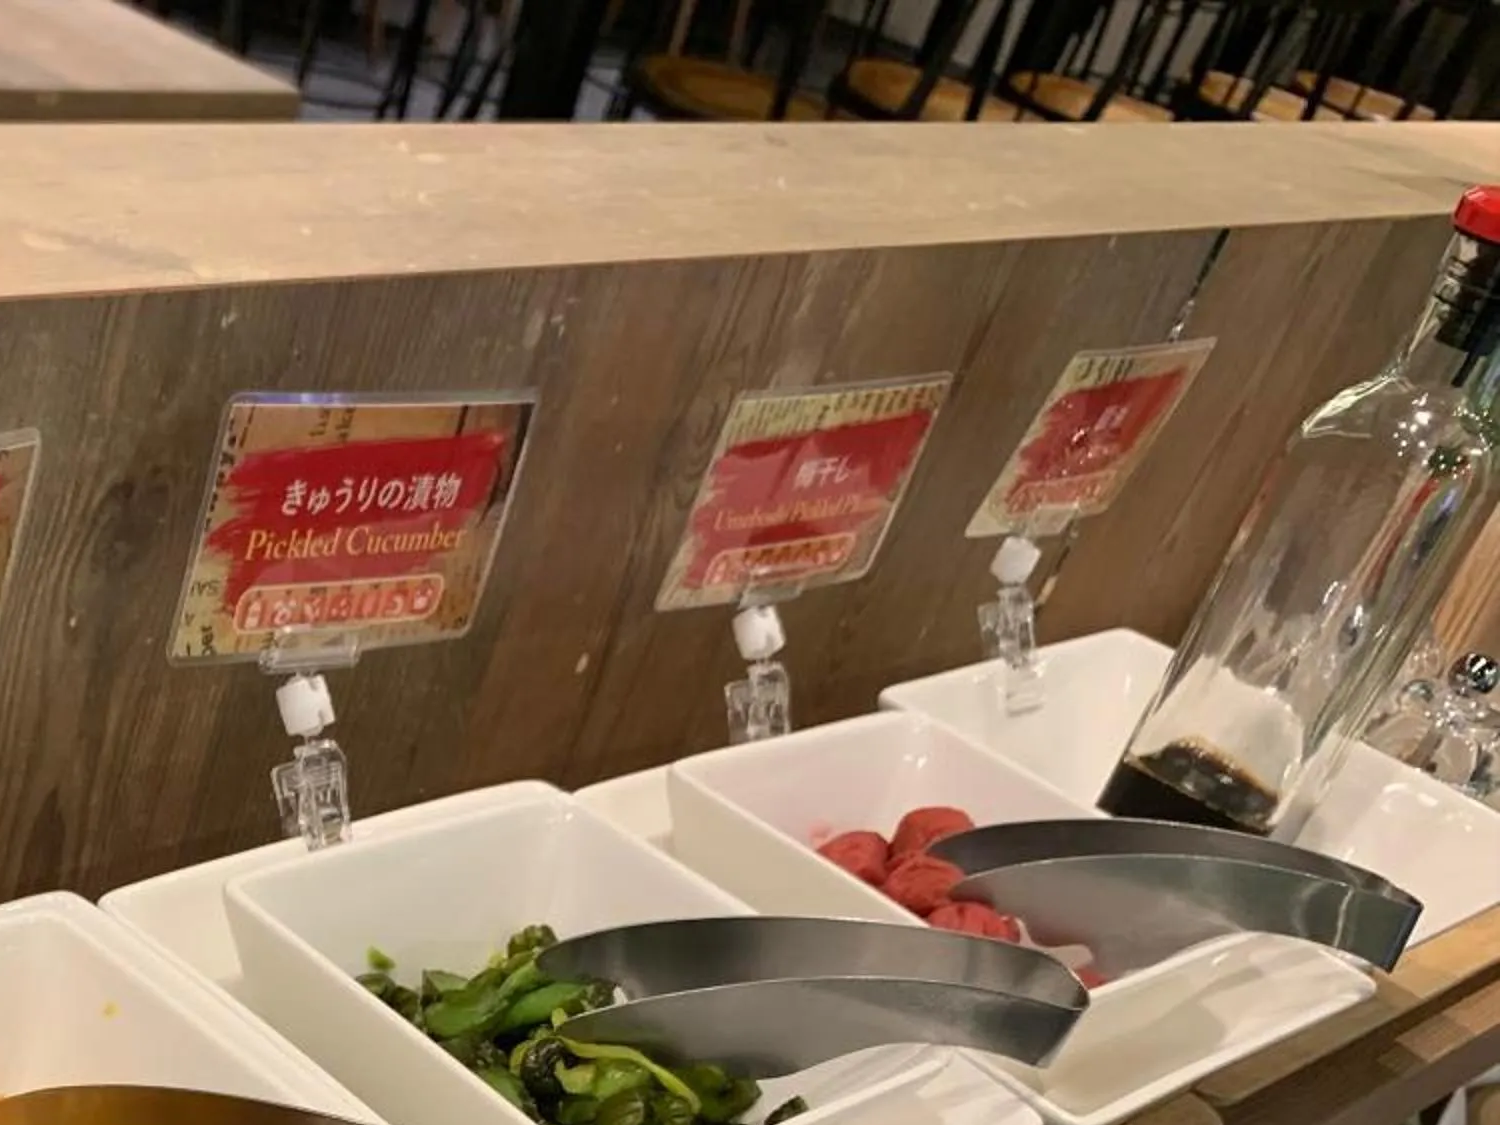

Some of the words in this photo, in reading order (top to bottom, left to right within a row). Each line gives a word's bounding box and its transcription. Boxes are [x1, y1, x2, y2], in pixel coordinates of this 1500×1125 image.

[281, 472, 462, 515] きゅうりの漬物
[245, 526, 342, 560] Pickled
[346, 521, 467, 556] Cucumber
